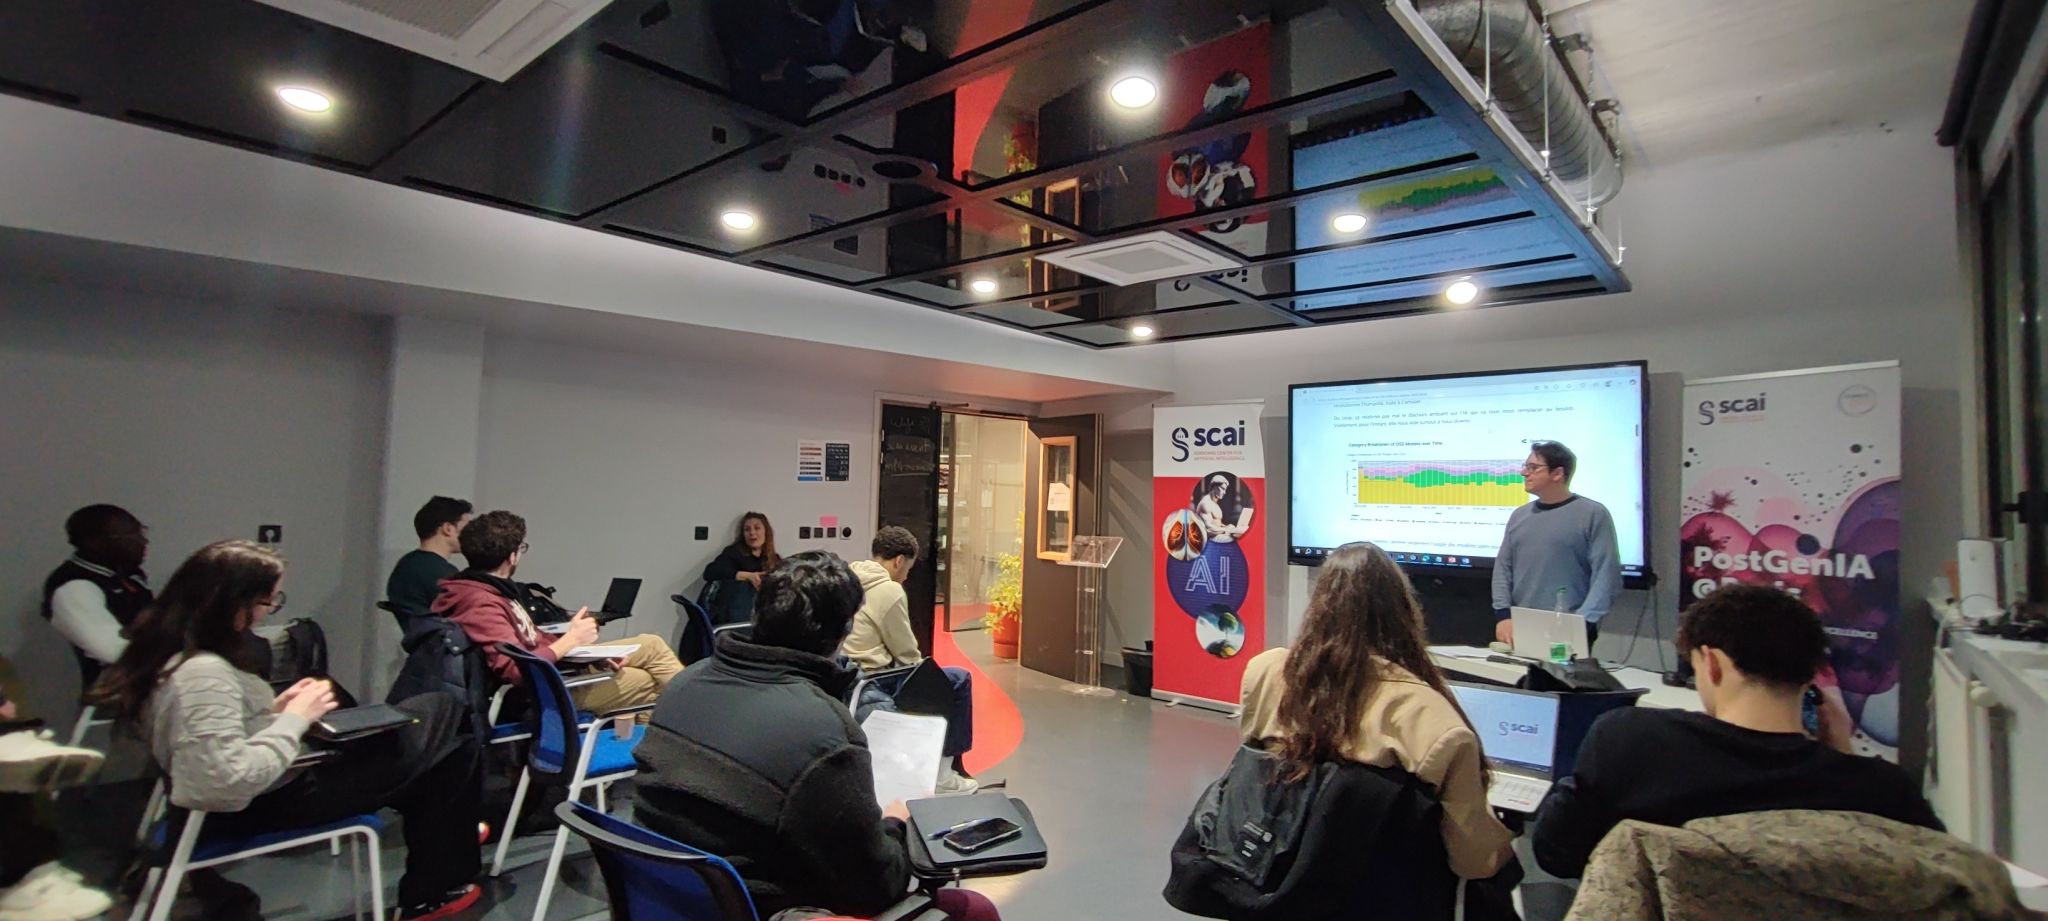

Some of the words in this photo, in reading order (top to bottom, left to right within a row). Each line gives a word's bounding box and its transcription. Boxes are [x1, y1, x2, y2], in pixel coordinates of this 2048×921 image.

[1719, 392, 1767, 414] scai
[1194, 420, 1245, 447] scai
[1185, 554, 1231, 595] AI
[1693, 545, 1876, 580] PostGenIA
[1511, 723, 1539, 734] scai
